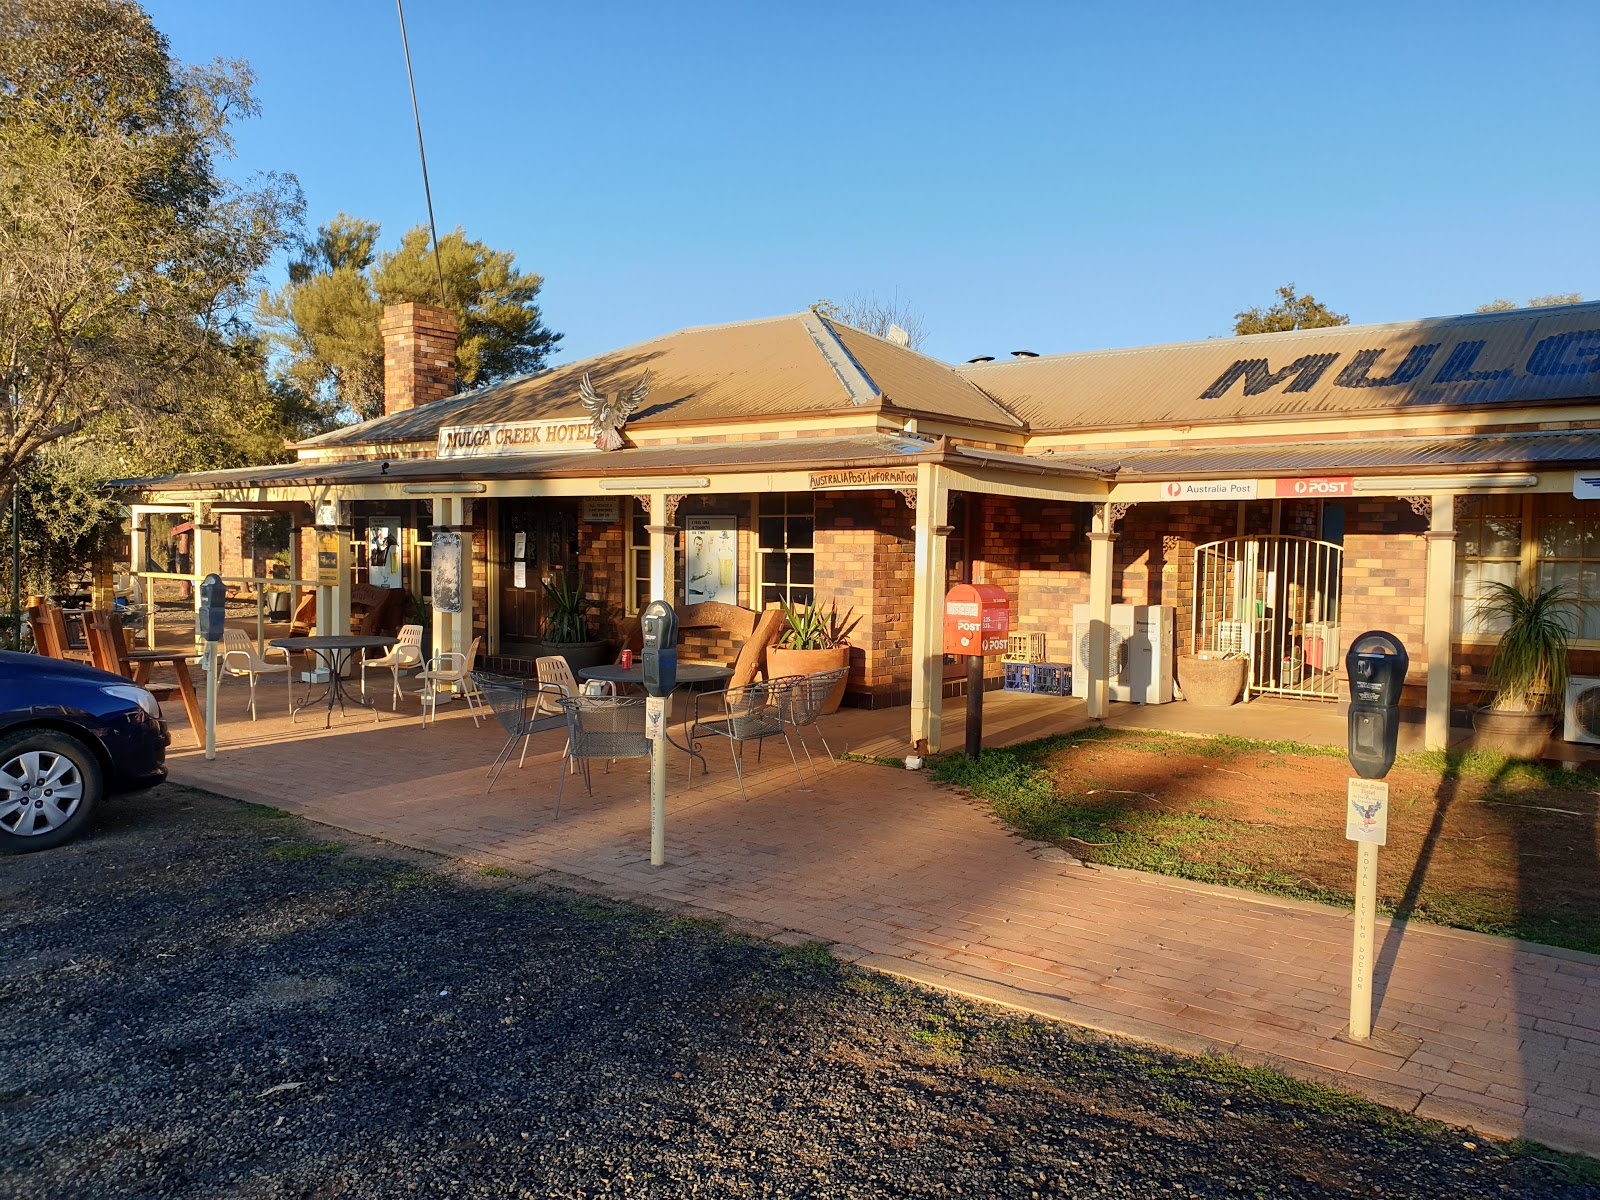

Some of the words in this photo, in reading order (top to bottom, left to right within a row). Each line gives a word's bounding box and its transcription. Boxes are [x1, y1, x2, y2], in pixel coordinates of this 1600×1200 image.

[447, 430, 492, 449] MULGA
[495, 426, 542, 445] CREEK
[545, 422, 597, 442] HOTEL
[1186, 484, 1227, 494] Australia
[1230, 484, 1251, 493] Post
[1308, 481, 1348, 493] POST
[957, 622, 981, 632] POST
[989, 639, 1009, 651] POST
[1362, 851, 1370, 887] ROYAL
[1357, 946, 1365, 990] DOCTOR
